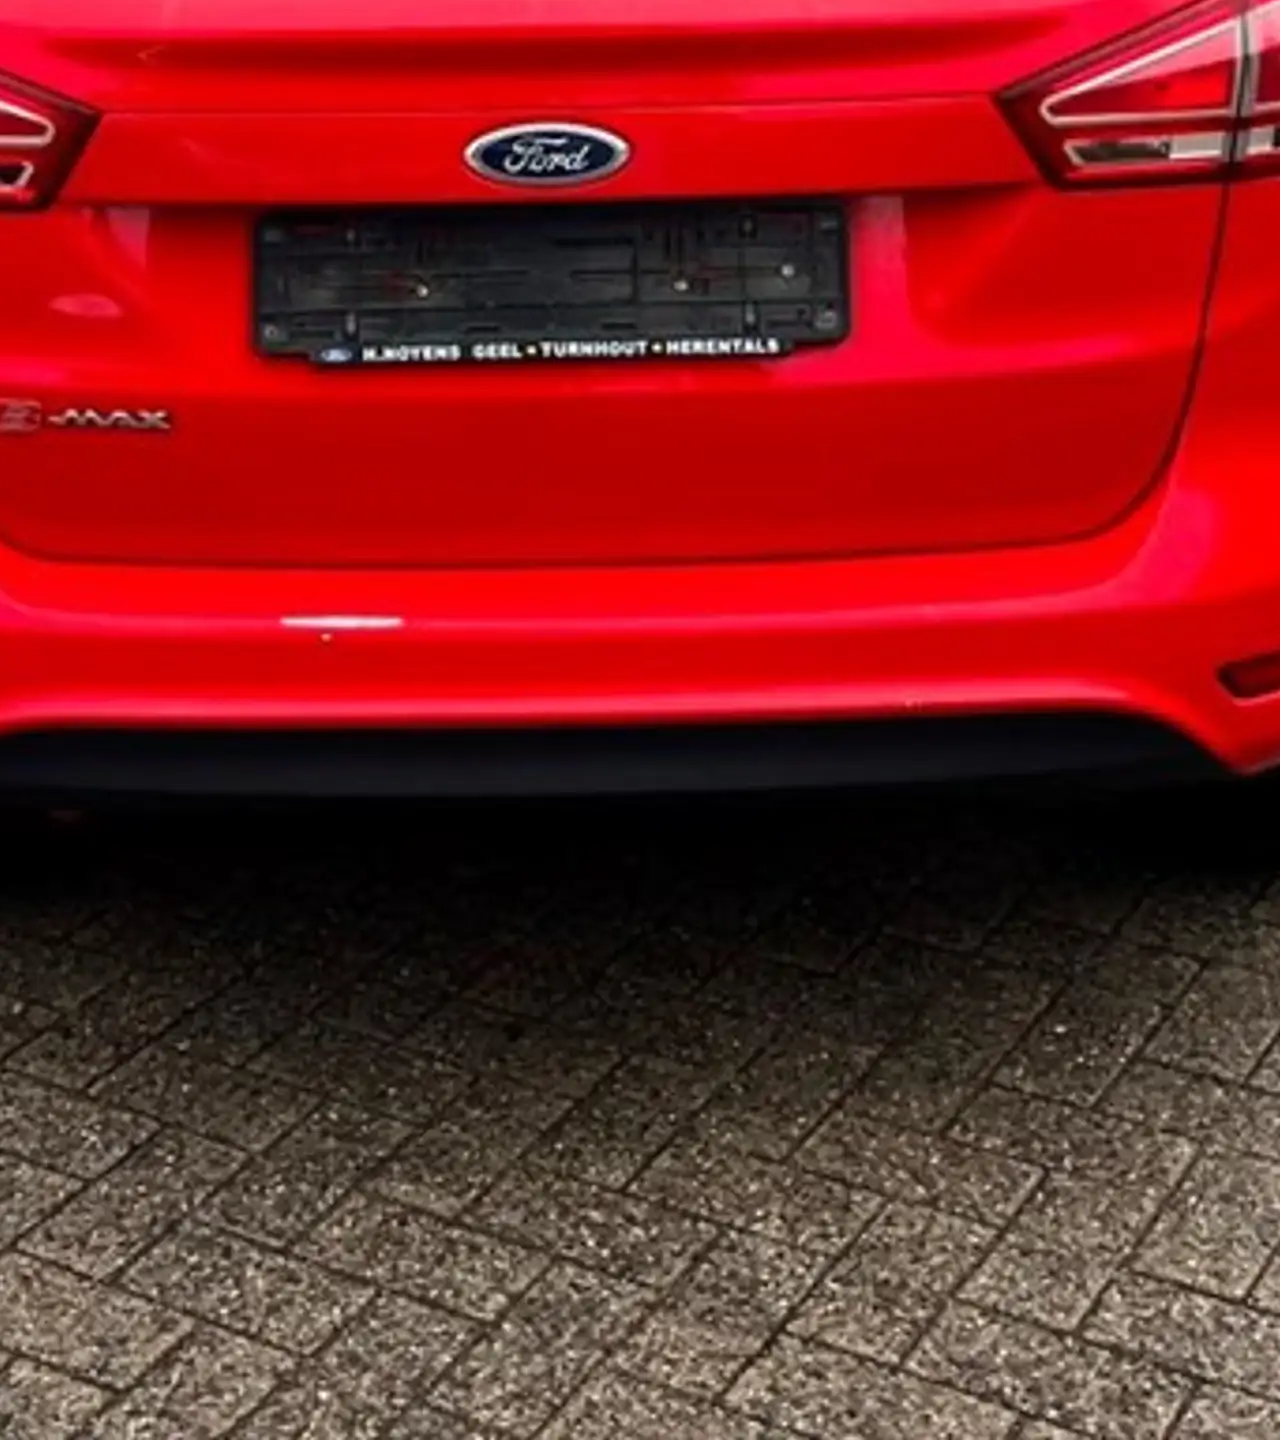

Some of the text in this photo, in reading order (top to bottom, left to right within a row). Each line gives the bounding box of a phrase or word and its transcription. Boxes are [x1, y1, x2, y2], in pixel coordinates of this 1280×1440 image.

[504, 137, 592, 174] Ford
[473, 342, 522, 358] GEEL
[540, 341, 648, 358] TURNHOUT
[665, 338, 780, 354] HERENTALS
